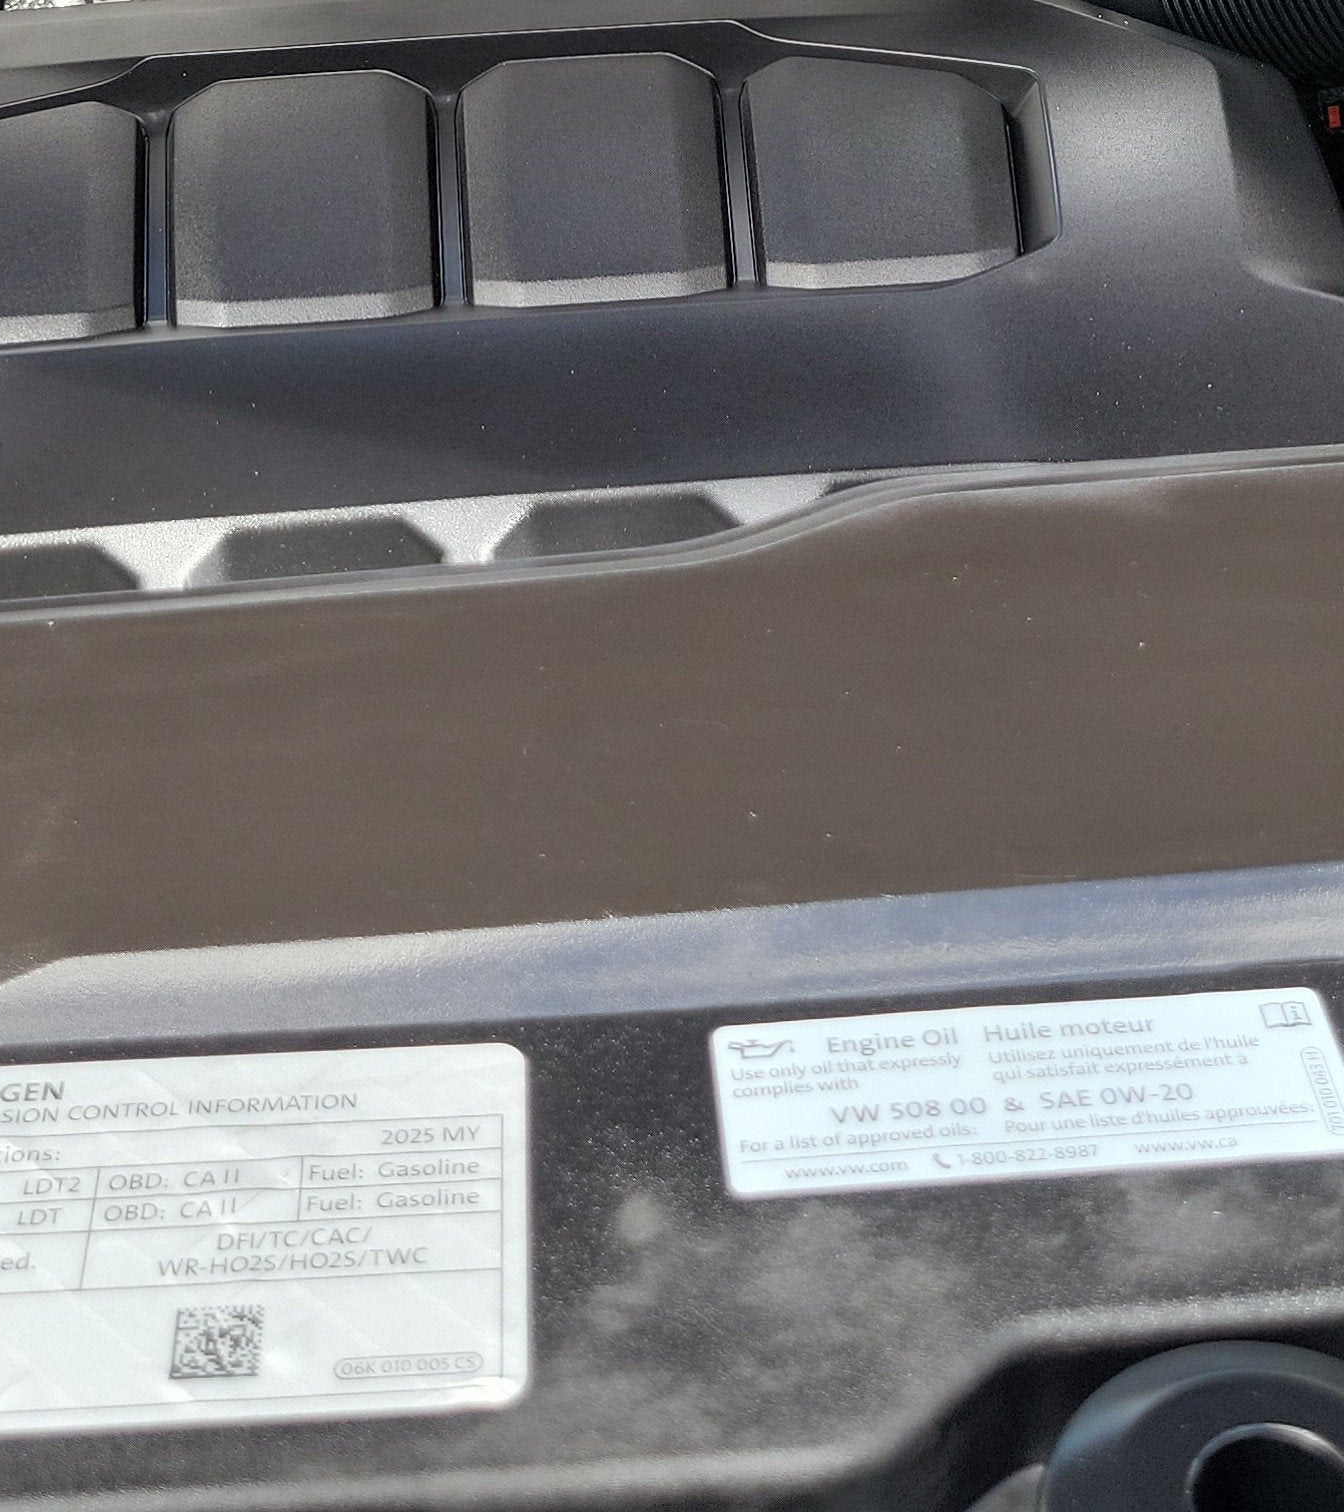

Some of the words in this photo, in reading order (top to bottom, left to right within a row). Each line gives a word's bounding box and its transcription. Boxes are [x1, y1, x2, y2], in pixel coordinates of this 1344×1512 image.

[825, 1032, 916, 1057] Engine
[921, 1025, 959, 1048] Oil
[983, 1021, 1053, 1043] Huile
[1060, 1016, 1155, 1040] moteur
[988, 1047, 1055, 1064] Utilisez
[1062, 1041, 1173, 1061] uniquement
[1178, 1038, 1200, 1052] de
[1203, 1034, 1259, 1051] l'huile
[730, 1067, 766, 1081] Use
[769, 1062, 806, 1079] only
[811, 1061, 832, 1075] oil
[837, 1057, 875, 1072] that
[879, 1051, 962, 1073] expressly
[992, 1067, 1022, 1085] qui
[1026, 1060, 1100, 1080] satisfait
[1104, 1054, 1232, 1075] expressément
[1237, 1051, 1248, 1065] à
[732, 1080, 813, 1099] complies
[818, 1075, 860, 1092] with
[829, 1103, 880, 1124] VW
[889, 1098, 941, 1120] 508
[950, 1095, 988, 1115] 00
[1003, 1096, 1025, 1113] &
[1039, 1089, 1092, 1109] SAE
[1100, 1082, 1194, 1106] 0W-20
[68, 1100, 178, 1122] CONTROL
[187, 1092, 359, 1115] INFORMATION
[1004, 1117, 1048, 1134] Pour
[1053, 1116, 1087, 1130] une
[1090, 1112, 1128, 1128] liste
[1131, 1108, 1200, 1126] d'huiles
[1204, 1099, 1314, 1123] approuvées:
[380, 1126, 436, 1146] 2025
[442, 1124, 482, 1143] MY
[740, 1138, 768, 1154] For
[773, 1139, 784, 1150] a
[789, 1134, 818, 1149] list
[823, 1132, 842, 1147] of
[847, 1126, 934, 1147] approved
[939, 1122, 978, 1138] oils:
[784, 1158, 908, 1179] www.vw.com
[955, 1143, 1098, 1167] 1-800-822-8987
[1134, 1135, 1238, 1155] www.vw.ca
[22, 1176, 81, 1196] LDT2
[108, 1172, 170, 1192] OBD:
[183, 1170, 220, 1188] CA
[223, 1167, 241, 1185] II
[307, 1163, 364, 1182] Fuel:
[377, 1157, 481, 1179] Gasoline
[16, 1206, 63, 1227] LDT
[103, 1202, 166, 1223] OBD:
[179, 1200, 213, 1219] CA
[219, 1197, 237, 1215] II
[305, 1194, 363, 1214] Fuel:
[376, 1187, 481, 1210] Gasoline
[215, 1225, 373, 1251] DFI/TC/CAC/
[158, 1246, 428, 1278] WR-HO2S/HO2S/TWC
[340, 1361, 376, 1376] 06K
[381, 1359, 412, 1373] 010
[416, 1357, 450, 1371] 005
[454, 1356, 476, 1369] CS
